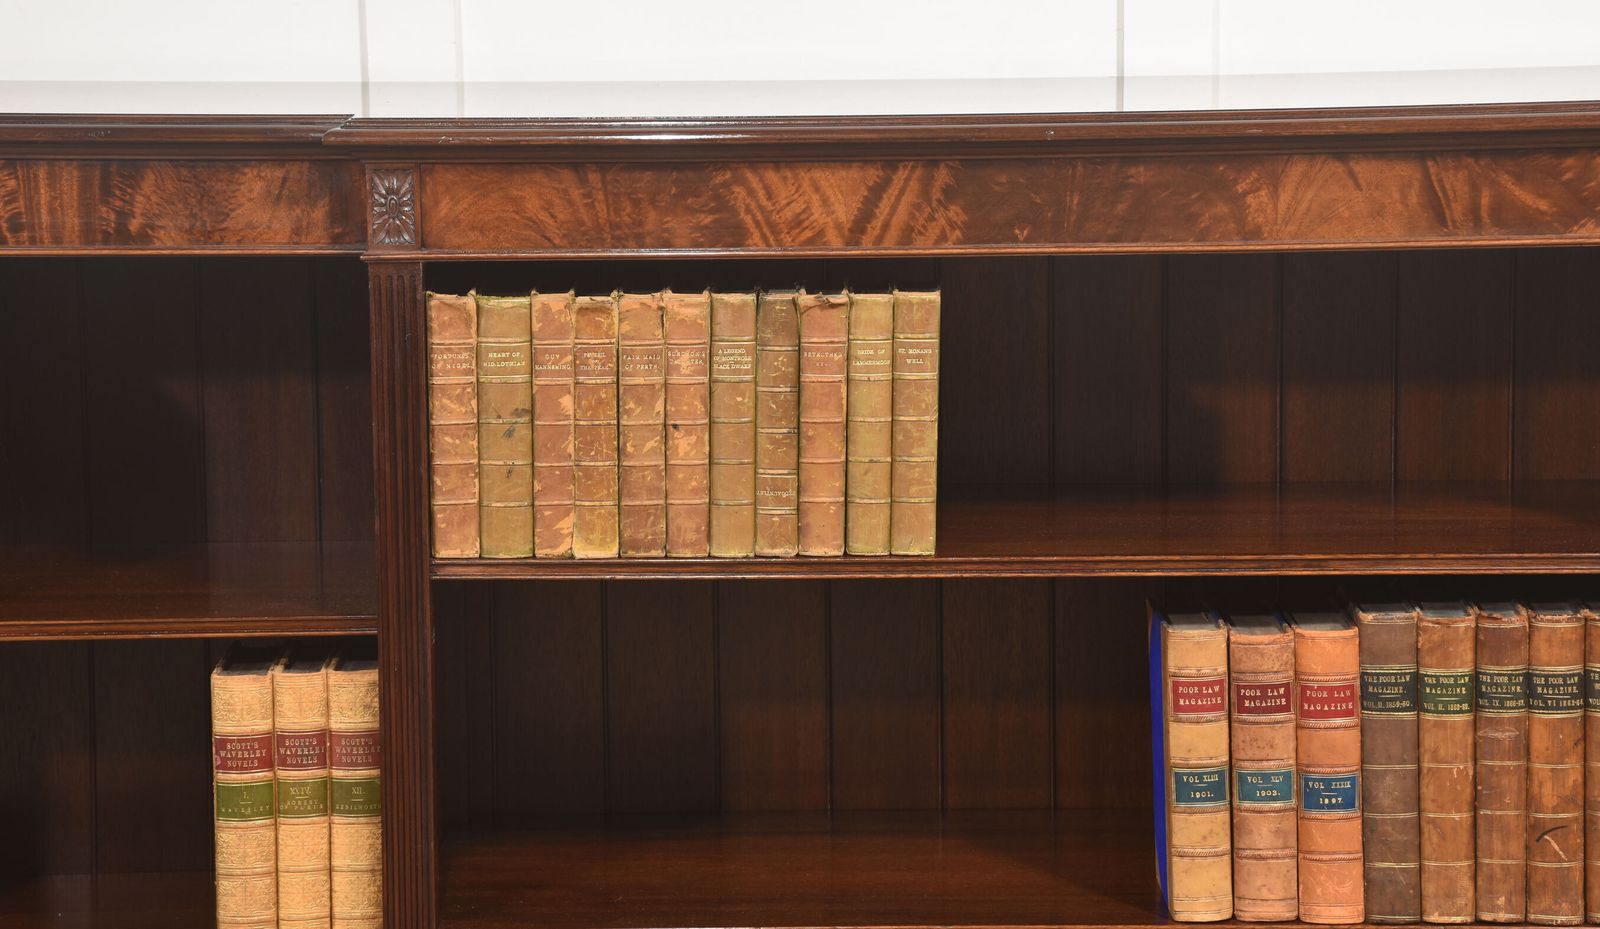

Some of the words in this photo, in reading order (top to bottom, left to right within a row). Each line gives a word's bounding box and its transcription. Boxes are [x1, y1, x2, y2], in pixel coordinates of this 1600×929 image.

[1380, 675, 1395, 683] POOR
[1493, 675, 1509, 683] POOR
[1533, 676, 1545, 684] THE
[1567, 676, 1579, 684] LAW
[1178, 686, 1199, 694] POOR
[1202, 685, 1220, 693] LAW
[1240, 688, 1261, 696] POOR
[1267, 687, 1286, 696] LAW
[1306, 690, 1328, 698] POOR
[1334, 689, 1352, 697] LAW
[1425, 687, 1467, 695] MAGAZINE
[1179, 697, 1222, 706] MAGAZINE
[1244, 698, 1287, 707] MAGAZINE
[1303, 702, 1353, 711] MAGAZINE
[227, 742, 259, 750] SCOTT'S
[285, 738, 317, 746] SCOTT'S
[220, 749, 267, 758] WAVERLEY
[280, 747, 325, 755] WAVERLEY
[335, 745, 381, 754] WAVERLEY
[287, 756, 318, 764] NOVELS
[341, 755, 372, 763] NOVELS
[227, 760, 258, 768] NOVELS
[1182, 775, 1200, 783] VOL
[1203, 774, 1219, 782] XLIII
[1271, 775, 1284, 783] XLV
[1308, 781, 1324, 789] VOL
[1190, 790, 1214, 798] 1901.
[1256, 789, 1281, 797] 1903.
